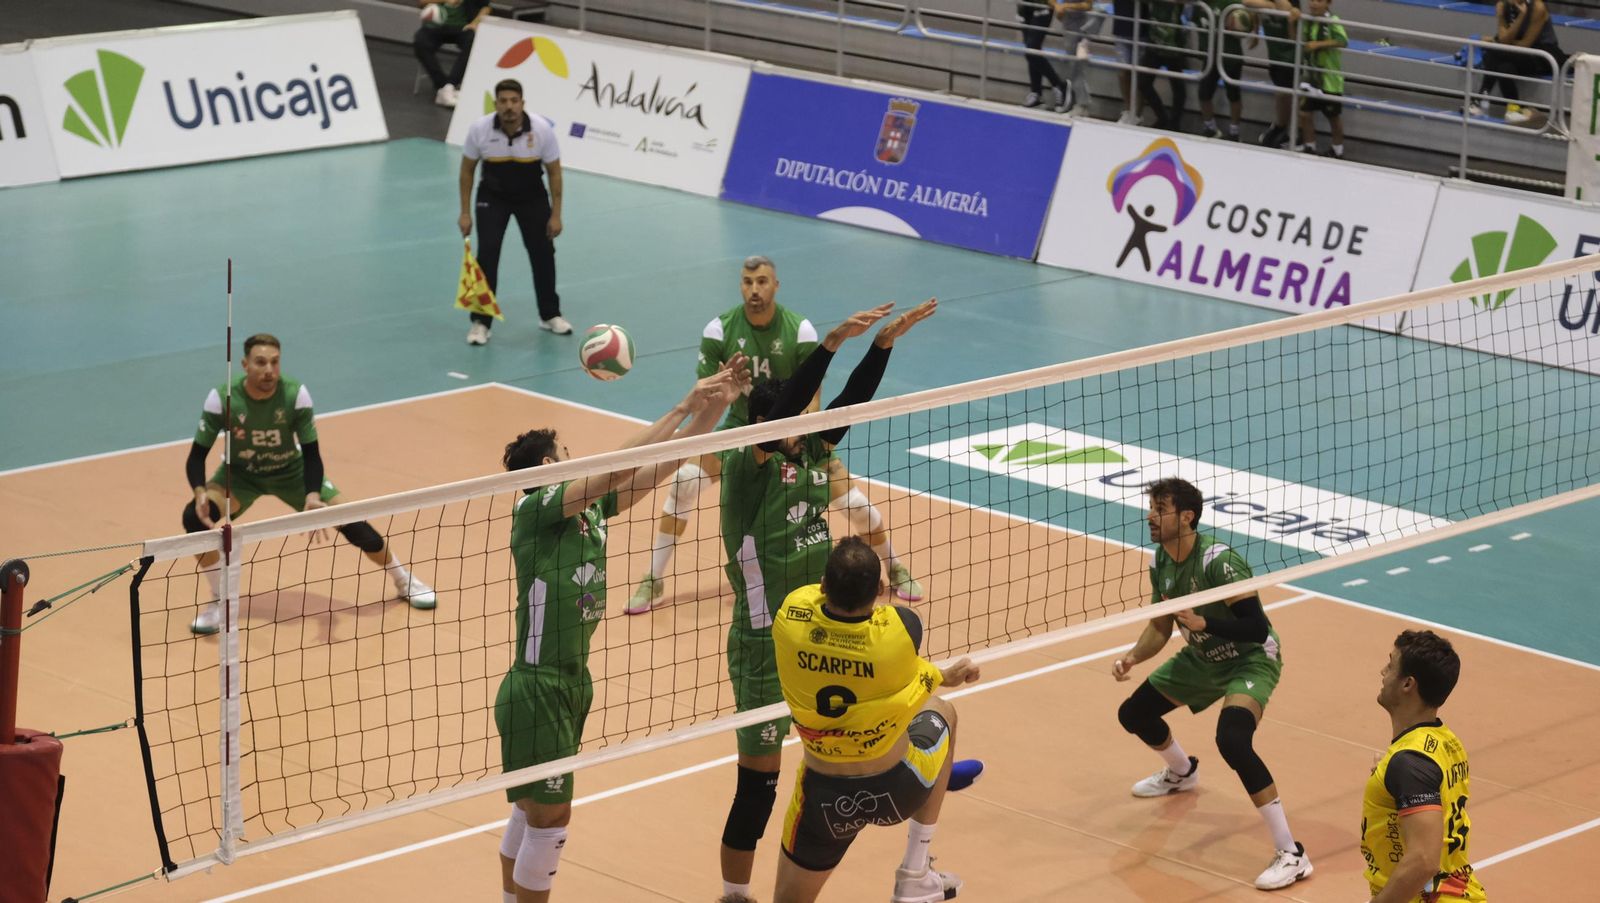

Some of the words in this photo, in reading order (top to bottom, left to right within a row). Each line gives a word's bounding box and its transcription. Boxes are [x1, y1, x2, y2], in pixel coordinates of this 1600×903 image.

[163, 63, 358, 130] Unicaja
[775, 157, 883, 195] DIPUTACIÓN
[884, 177, 906, 201] DE
[909, 184, 989, 217] ALMERÍA
[1206, 200, 1313, 247] COSTA
[1322, 220, 1369, 256] DE
[1157, 241, 1352, 309] ALMERÍA
[251, 429, 282, 447] 23
[1098, 468, 1371, 542] Uicaja
[789, 609, 810, 619] TSK
[798, 651, 875, 678] SCARPIN
